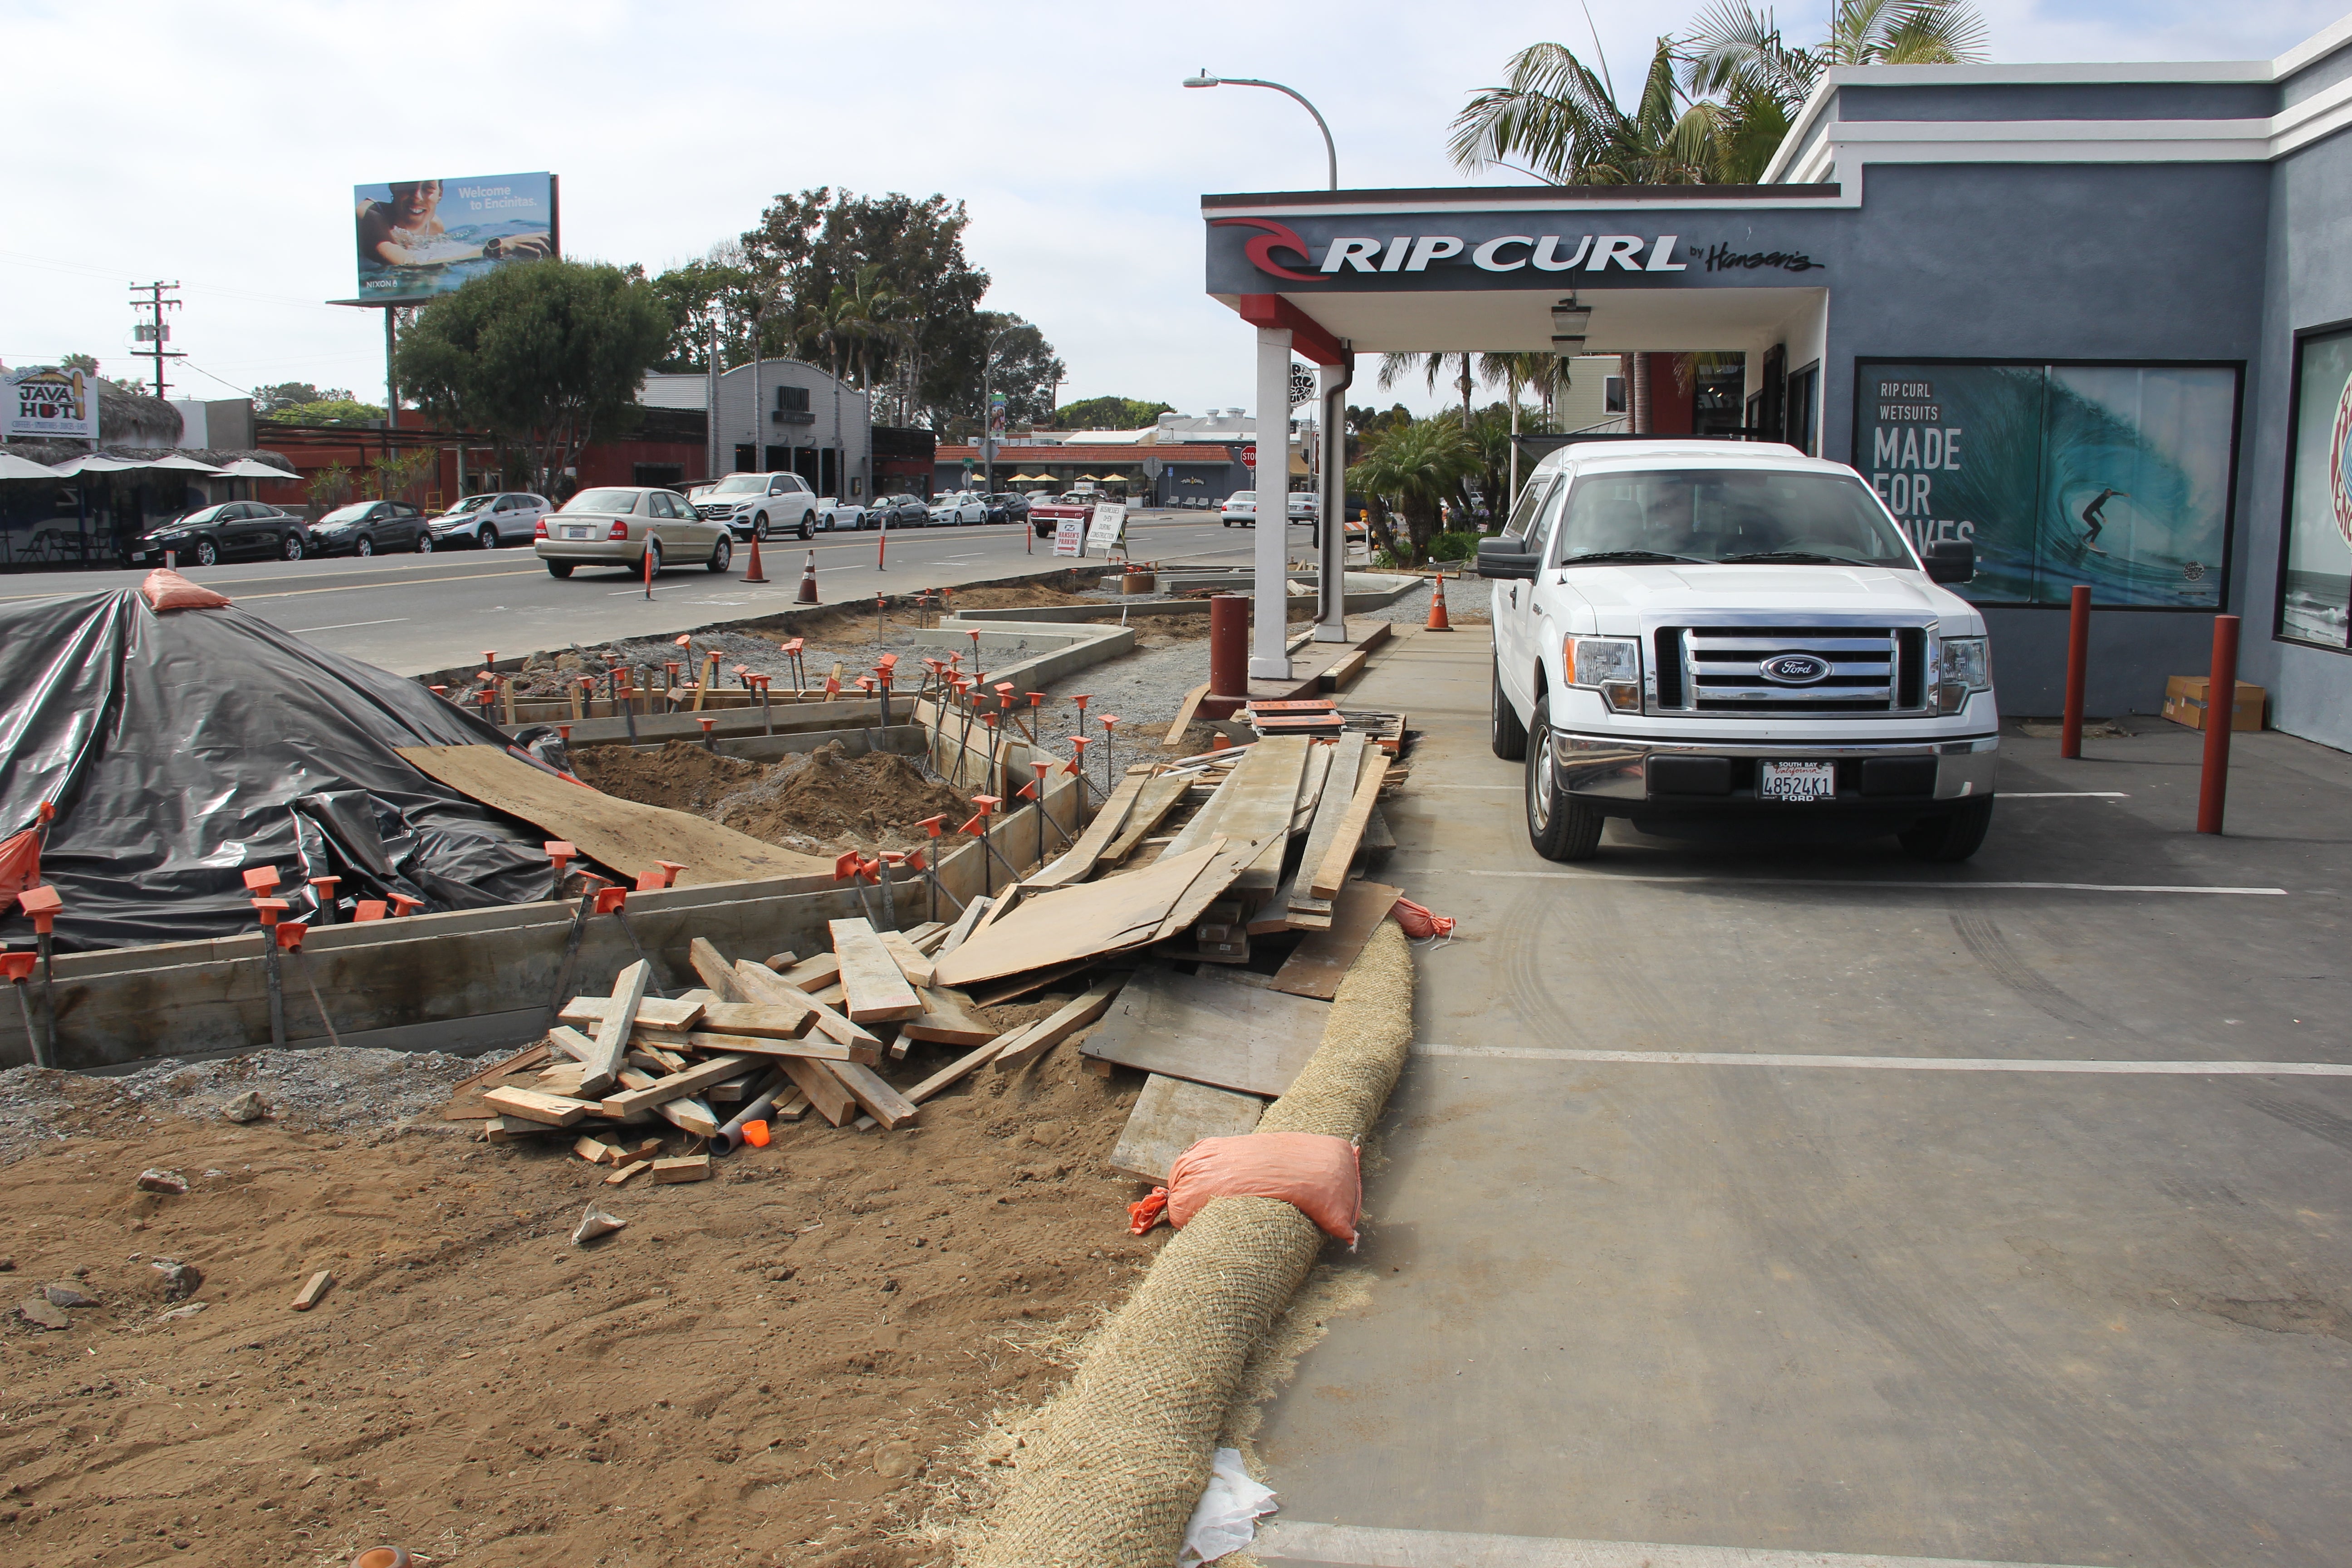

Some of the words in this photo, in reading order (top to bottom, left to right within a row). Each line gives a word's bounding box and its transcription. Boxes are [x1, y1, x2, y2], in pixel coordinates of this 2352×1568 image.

[458, 186, 511, 199] Welcome
[470, 200, 482, 210] to
[485, 196, 537, 209] Encinitas.
[1320, 236, 1464, 272] RIP
[1472, 235, 1687, 271] CURL
[1690, 246, 1704, 258] by
[1705, 241, 1825, 272] Hansen's
[19, 386, 74, 402] JAVA
[1881, 383, 1899, 397] RIP
[1902, 383, 1931, 397] CURL
[782, 387, 808, 411] UNION
[1880, 406, 1937, 420] WETSUITS
[1873, 427, 1961, 470] MADE
[1243, 452, 1256, 461] STO
[1873, 473, 1930, 515] FOR
[1090, 531, 1115, 540] CONSTRUCTION
[1781, 661, 1812, 674] Ford
[1775, 766, 1822, 776] California
[1764, 777, 1830, 795] 48524K1
